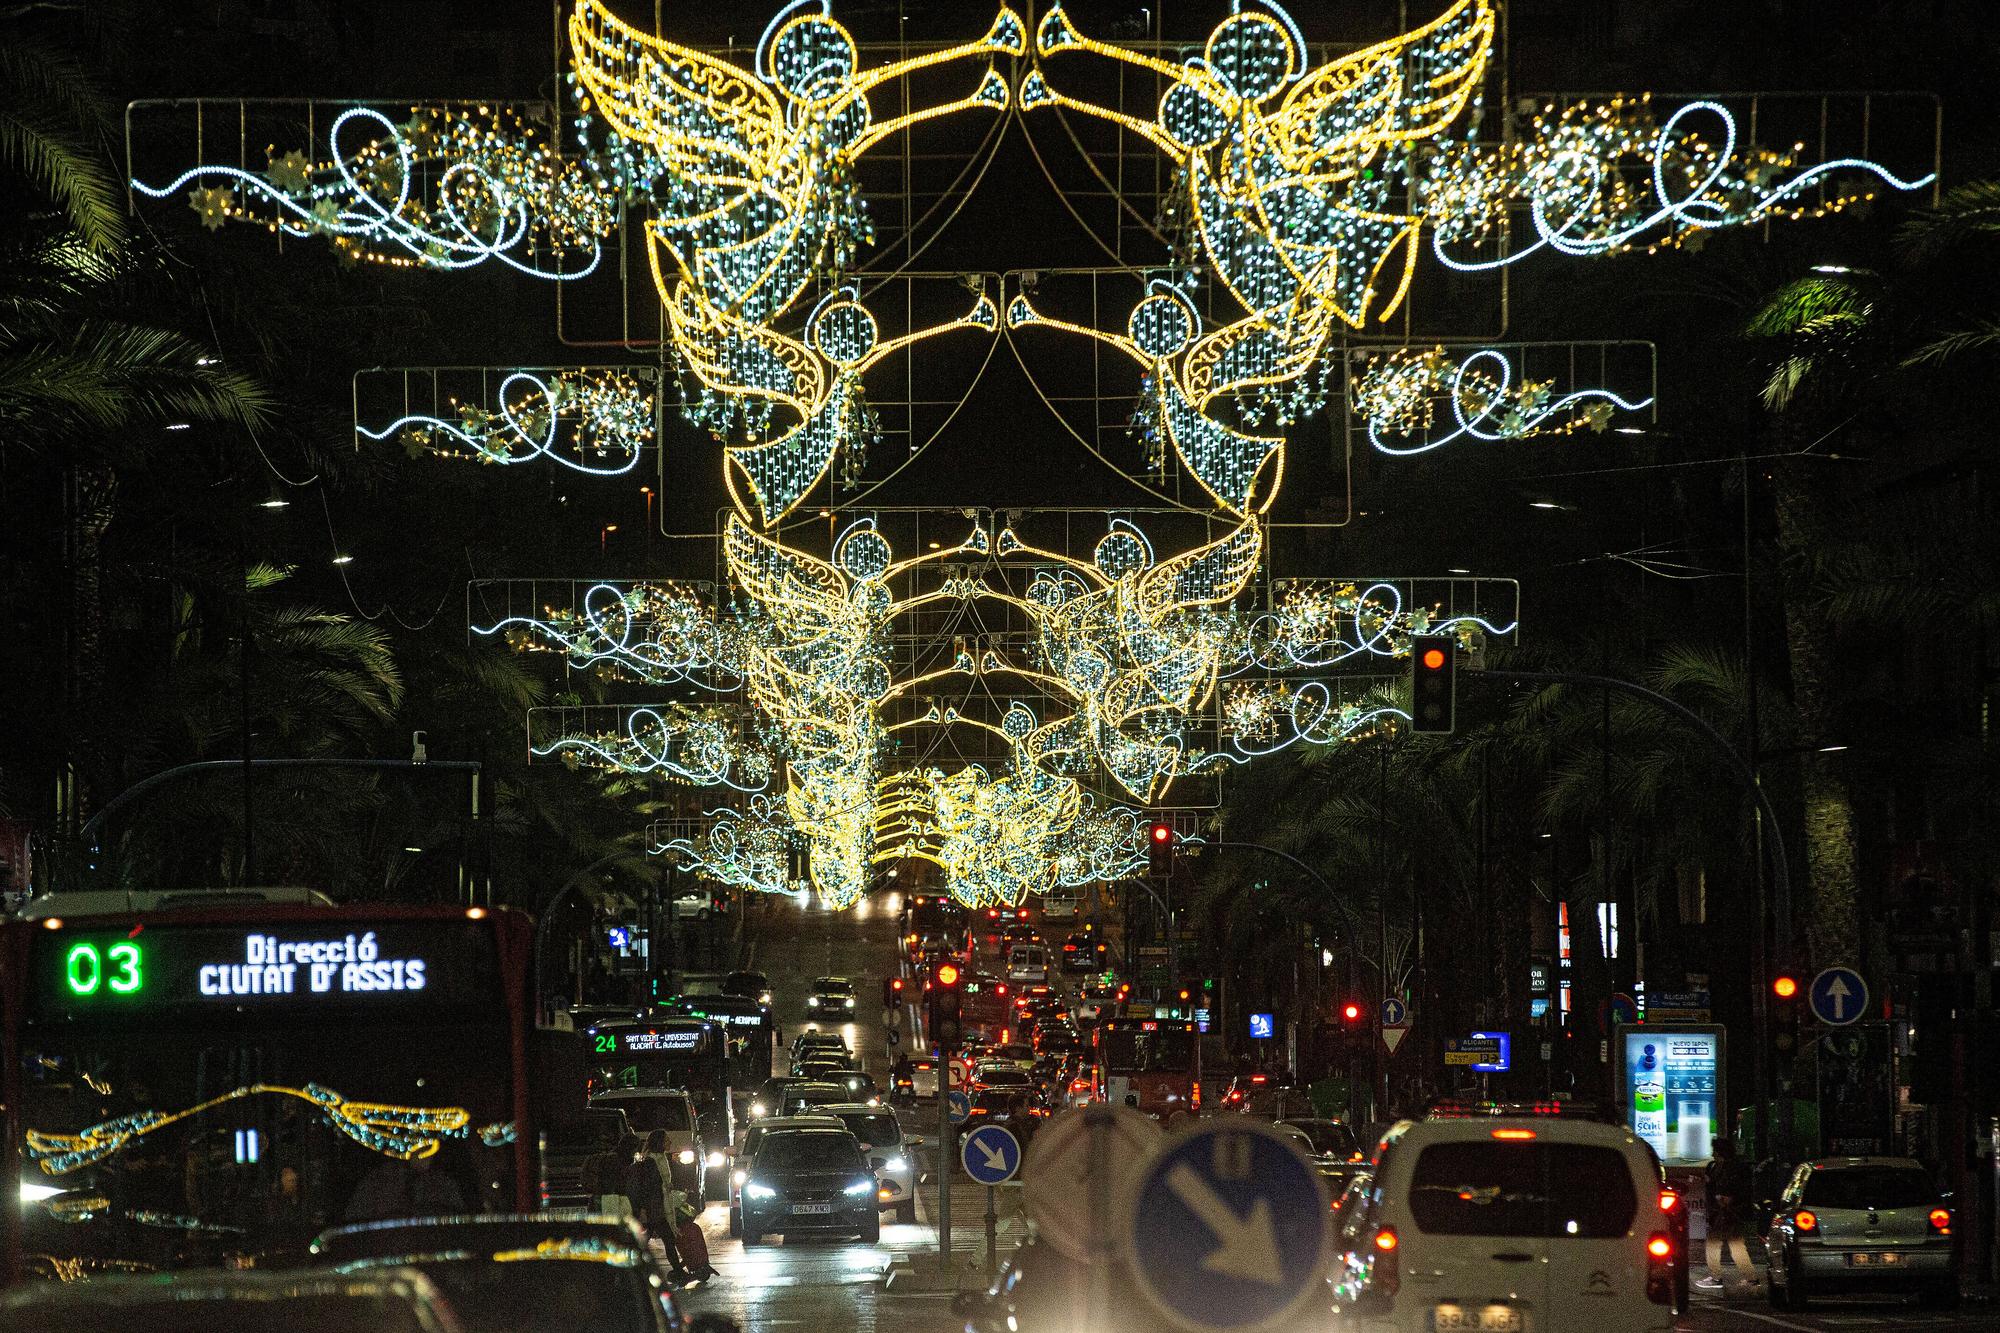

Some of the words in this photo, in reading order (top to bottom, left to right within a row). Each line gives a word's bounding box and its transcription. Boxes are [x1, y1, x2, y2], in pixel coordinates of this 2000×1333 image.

[247, 932, 379, 965] Direcció
[68, 943, 142, 994] 03
[200, 963, 298, 995] CIUTAT
[967, 983, 979, 993] 24
[595, 1035, 617, 1053] 24
[625, 1035, 640, 1043] SANT
[640, 1034, 659, 1043] VICENT
[664, 1033, 700, 1041] UNIVERSITAT
[630, 1042, 654, 1050] ALACANT
